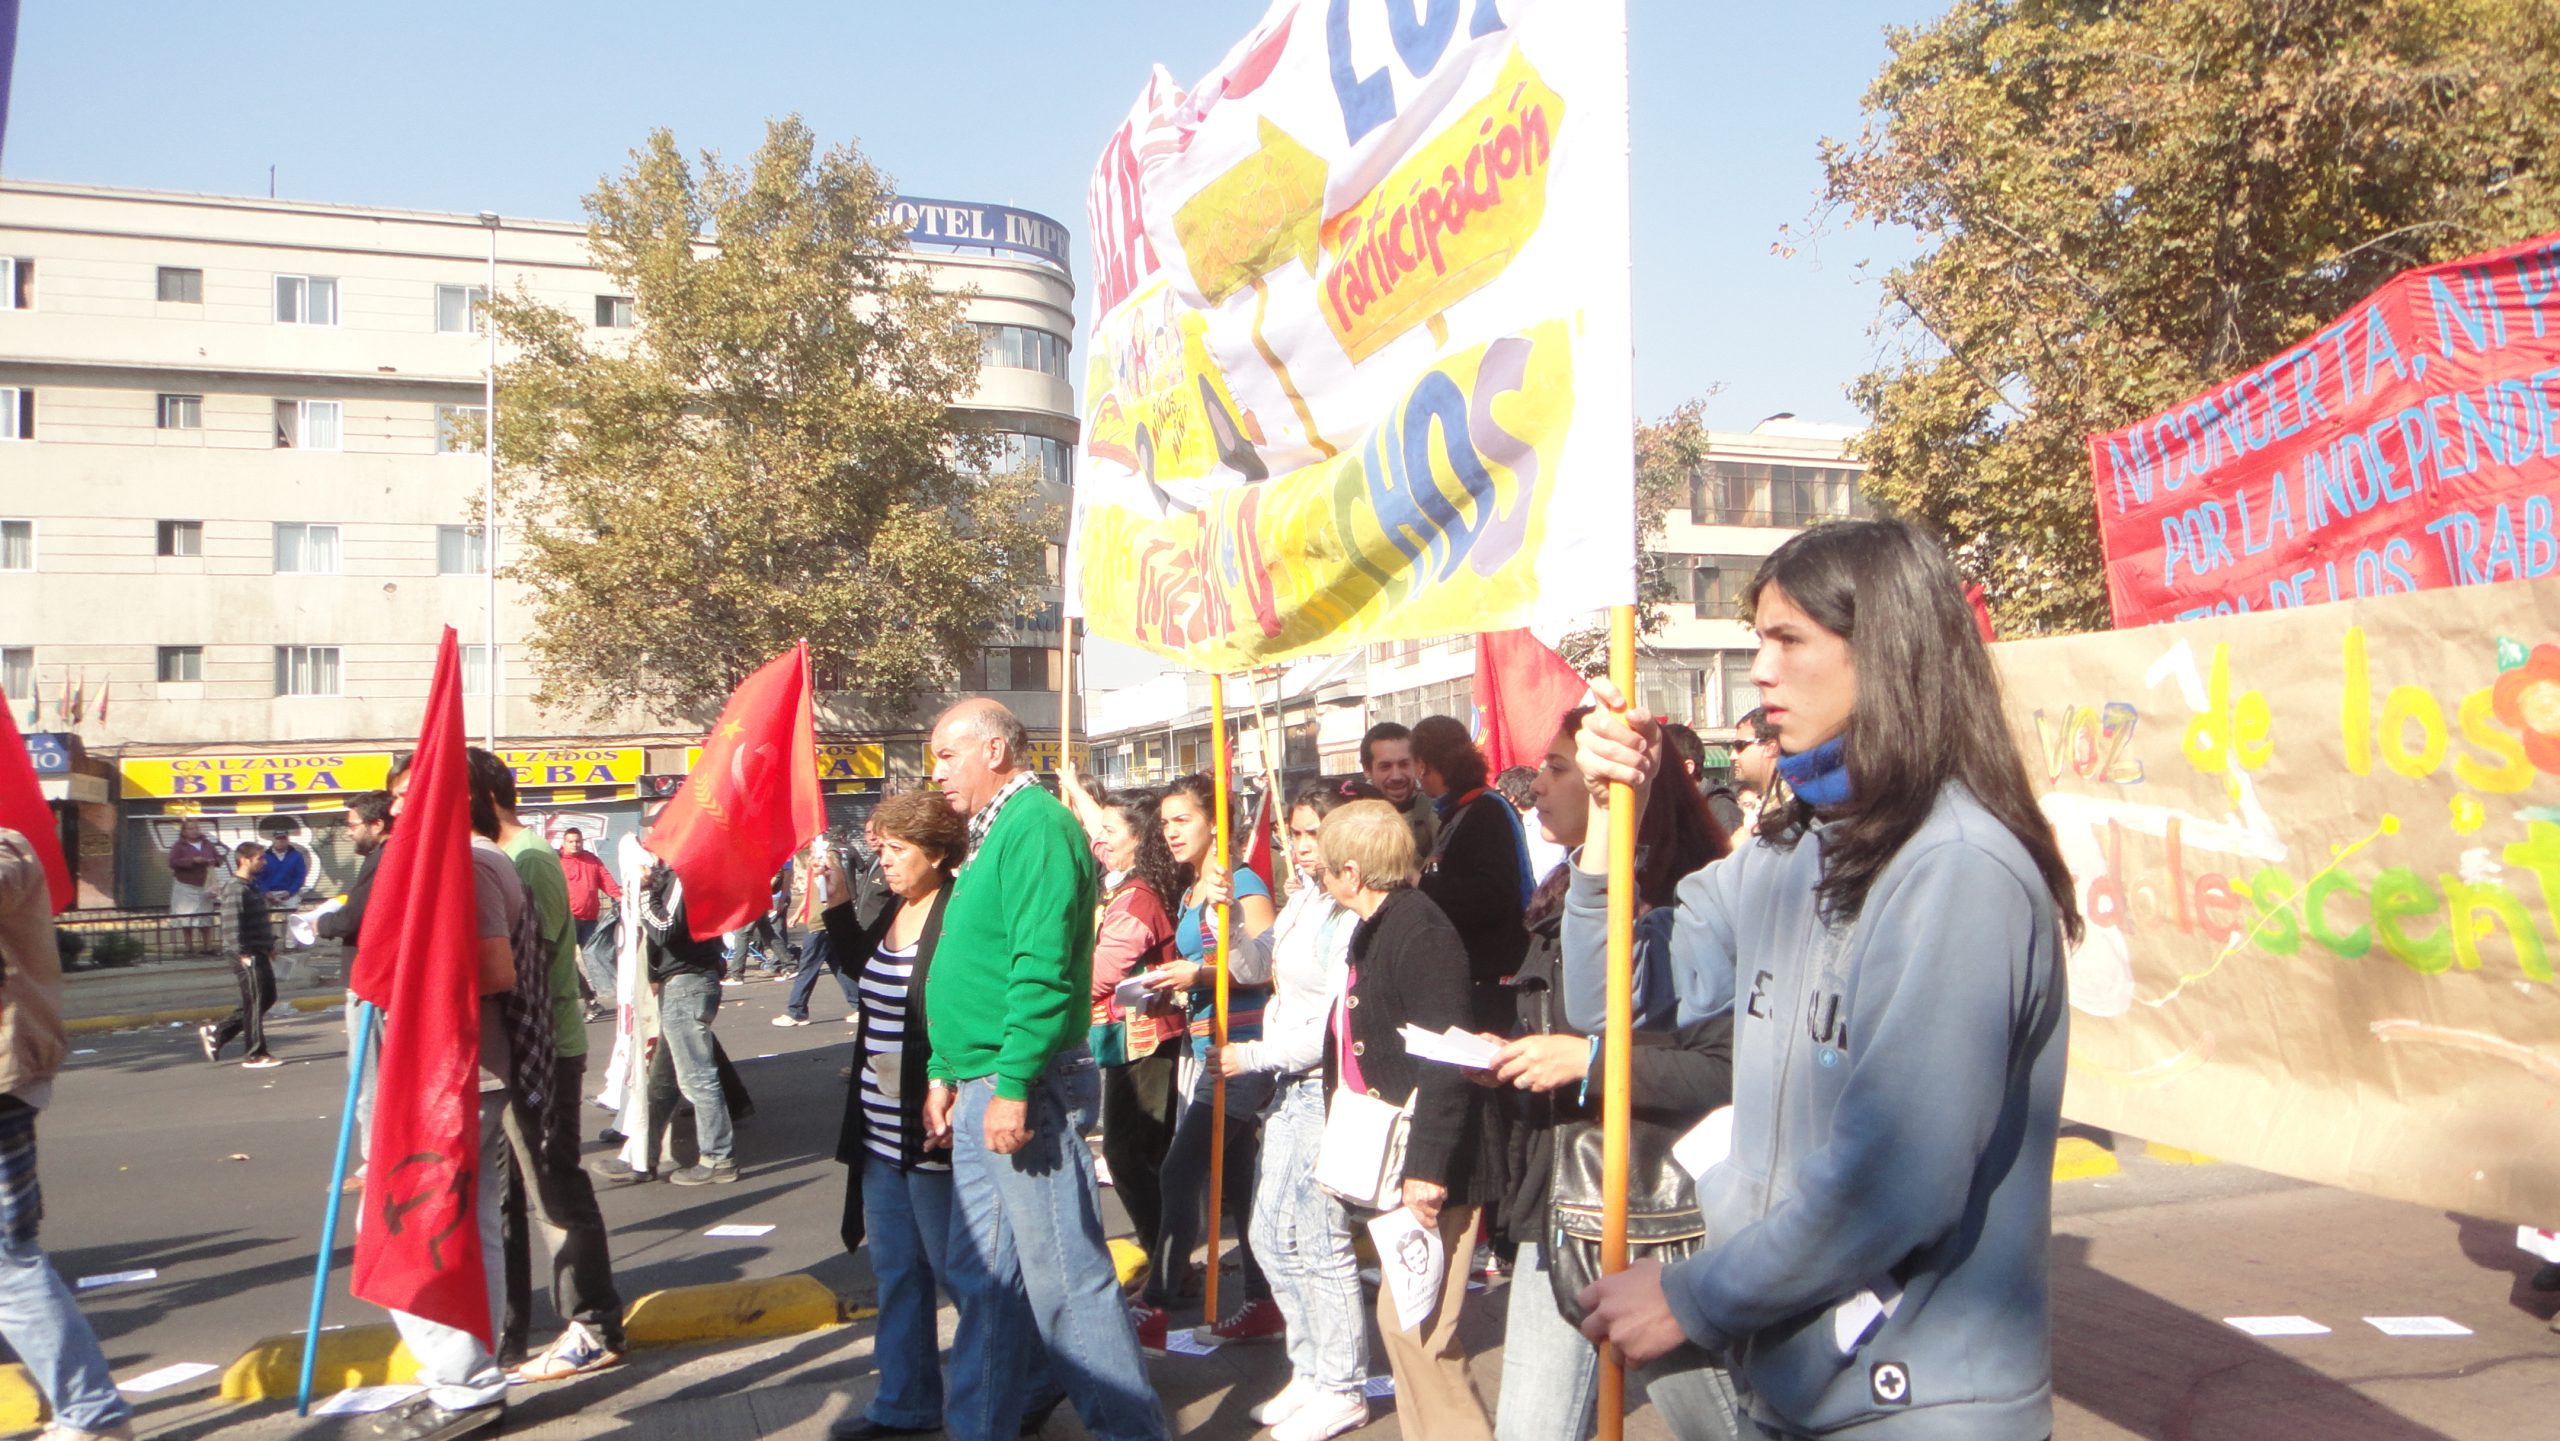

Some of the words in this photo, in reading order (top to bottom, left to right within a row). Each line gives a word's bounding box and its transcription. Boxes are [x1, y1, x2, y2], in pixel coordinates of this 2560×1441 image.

[1005, 213, 1069, 257] IMPE
[2109, 423, 2155, 513] NI
[2154, 303, 2427, 491] CONCERTA,
[2428, 264, 2507, 359] NI
[2161, 501, 2234, 587] POR
[2236, 471, 2295, 556] LA
[2182, 642, 2274, 773] de
[2341, 626, 2538, 794] los
[171, 756, 344, 772] CALZADOS
[172, 771, 343, 795] BEBA
[512, 758, 617, 784] EBA
[2086, 817, 2560, 983] dolescent
